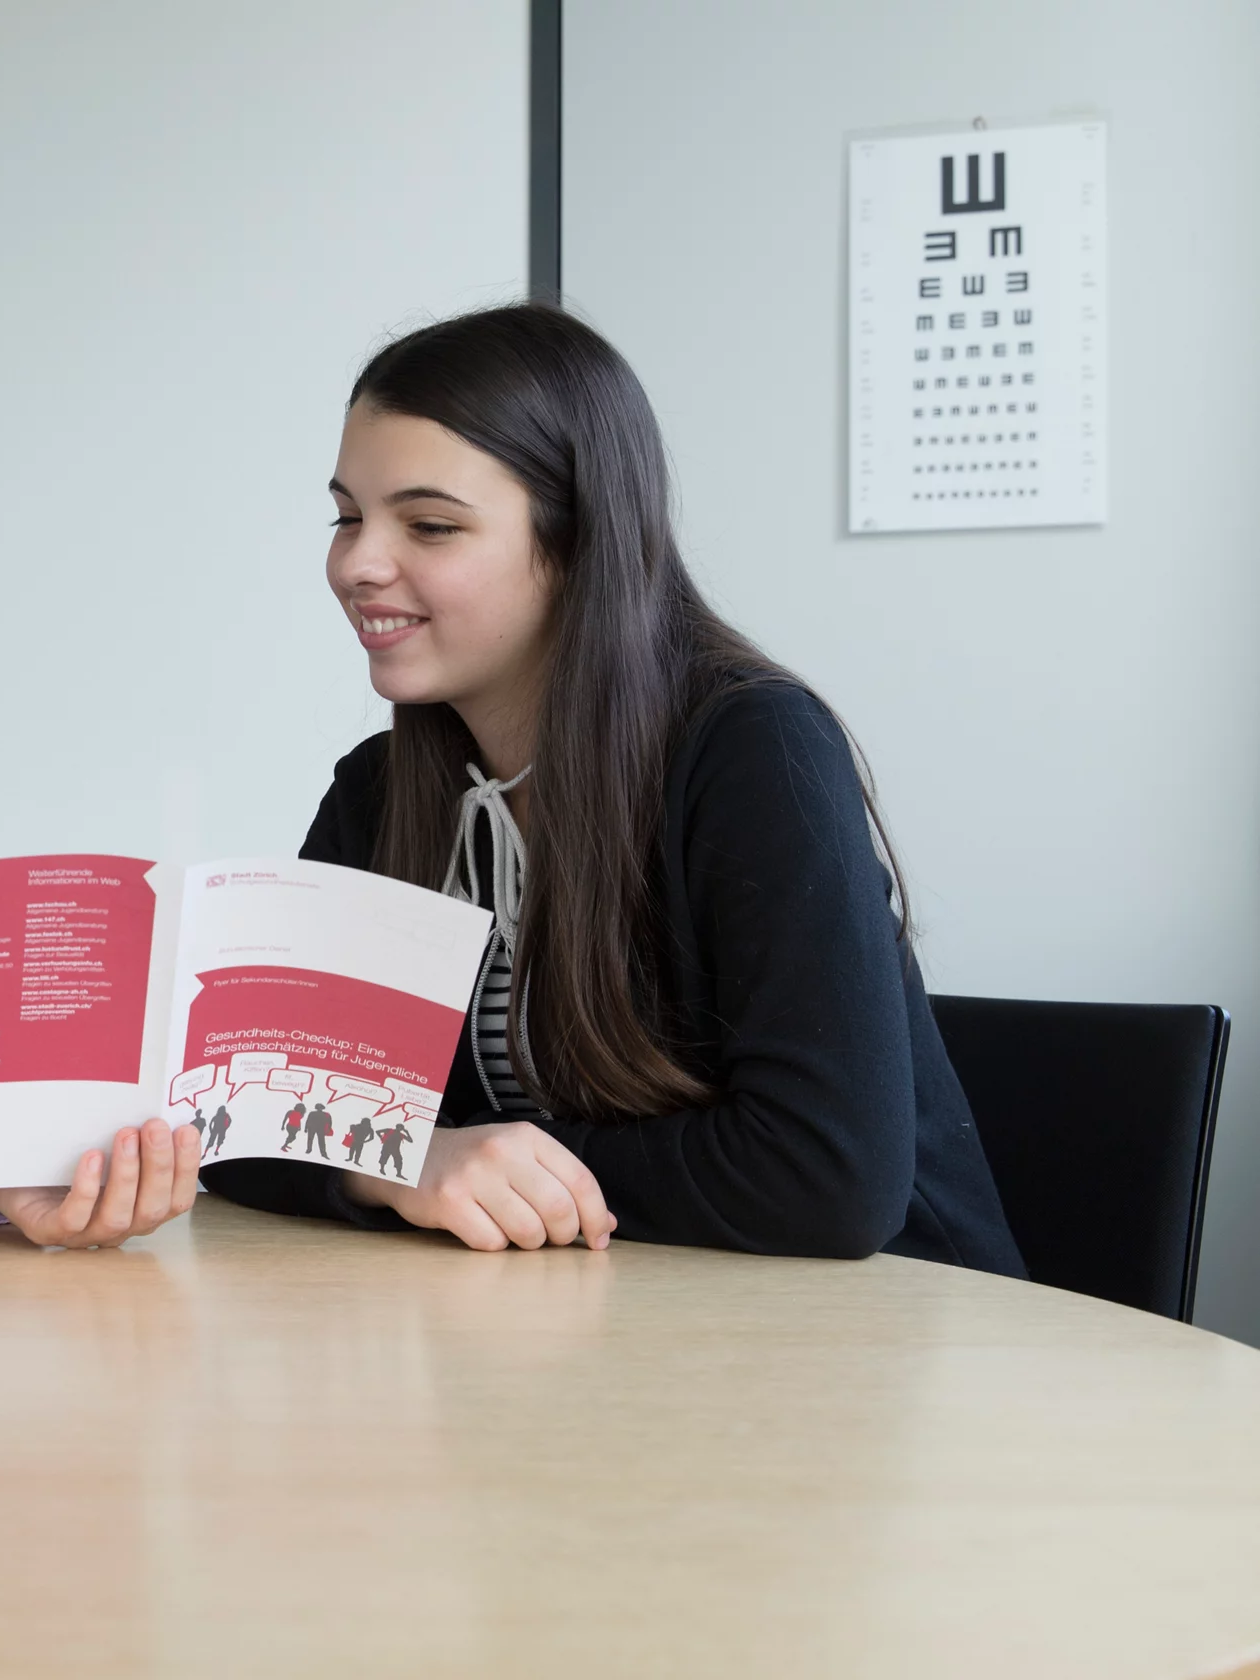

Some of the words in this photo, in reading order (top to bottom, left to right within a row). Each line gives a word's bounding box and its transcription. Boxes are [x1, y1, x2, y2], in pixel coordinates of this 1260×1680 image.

[28, 877, 86, 886] Informationen
[100, 877, 121, 886] Web
[205, 1028, 354, 1050] Gesundheits-Checkup:
[357, 1042, 386, 1059] Eine
[203, 1041, 328, 1059] Selbsteinschätzung
[330, 1049, 348, 1061] für
[349, 1054, 428, 1084] Jugendliche
